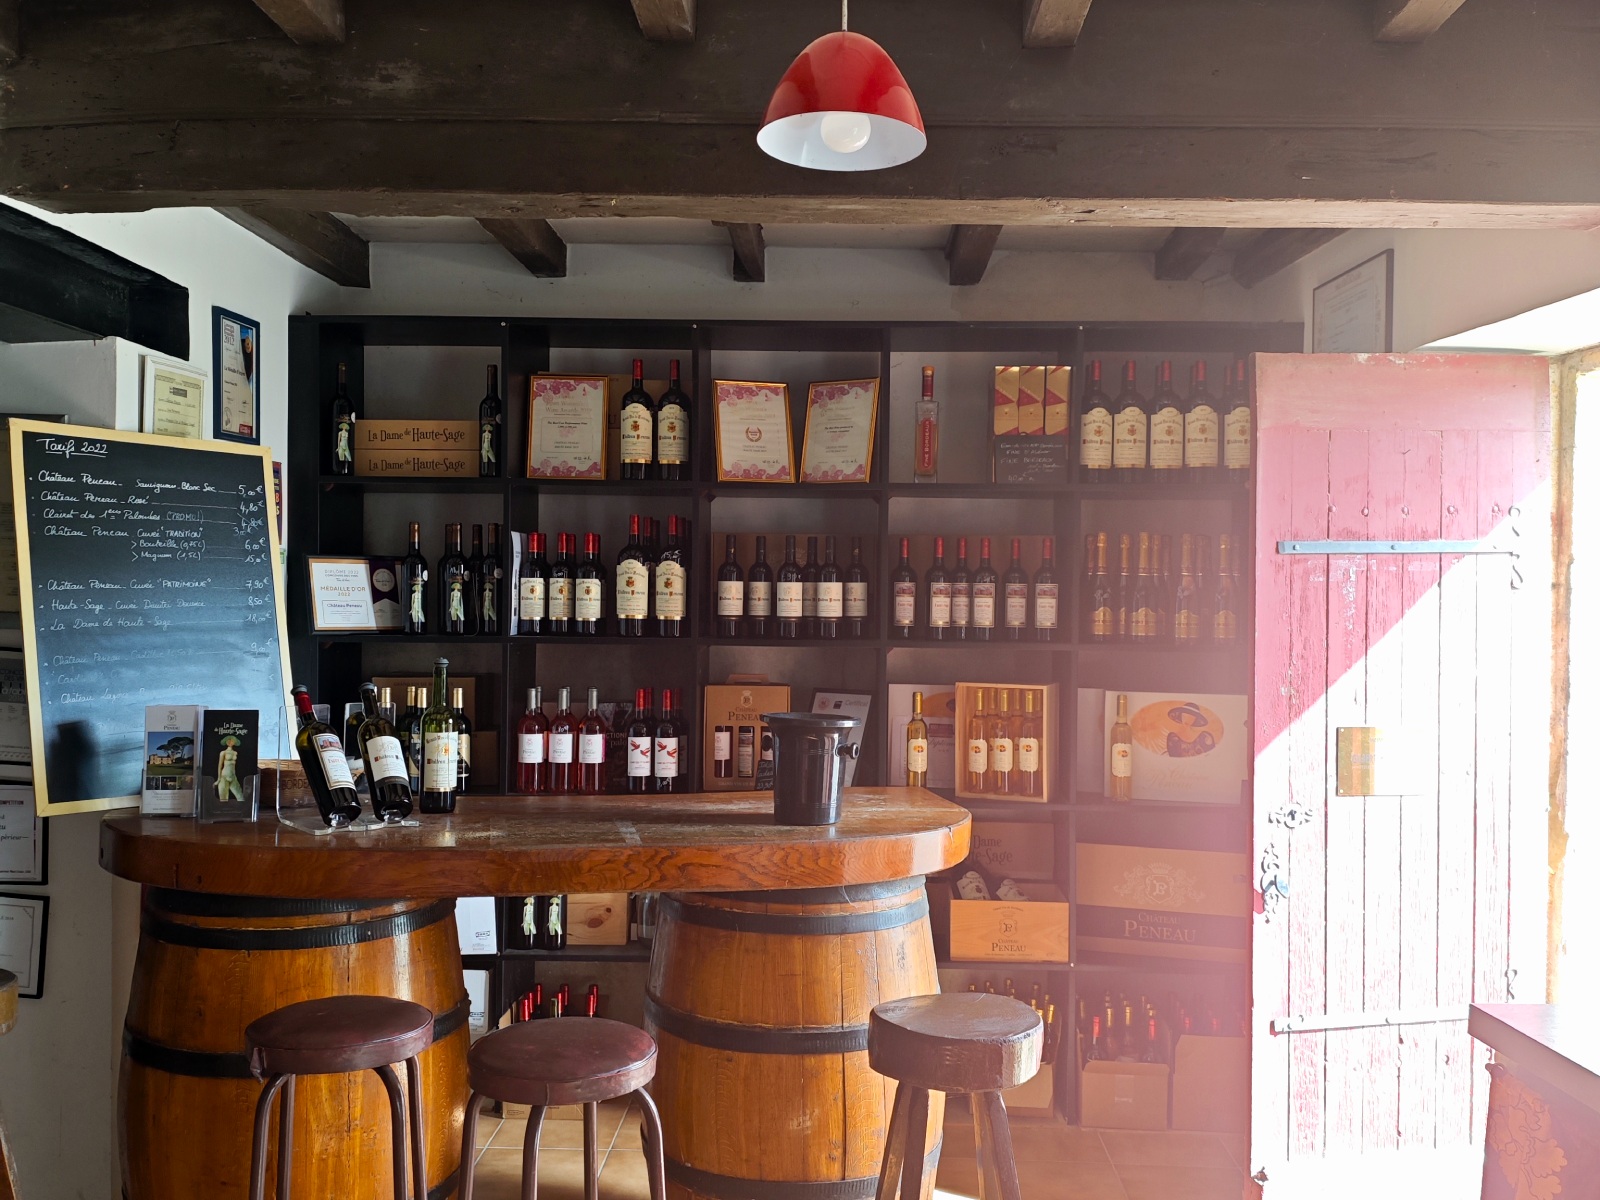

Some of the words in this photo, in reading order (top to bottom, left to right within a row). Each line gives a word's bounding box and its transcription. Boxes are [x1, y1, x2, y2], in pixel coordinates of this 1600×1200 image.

[368, 430, 378, 442] La
[380, 430, 403, 442] Dame
[404, 428, 411, 436] de
[412, 428, 465, 442] Haute-Sage
[80, 441, 108, 454] 2022
[368, 459, 378, 472] La
[381, 459, 404, 471] Dame
[404, 457, 412, 465] de
[412, 457, 466, 472] Haute-Sage
[38, 470, 76, 483] Château
[80, 473, 117, 486] Peneau
[181, 482, 200, 491] Blanc
[203, 483, 216, 492] Sec
[40, 491, 79, 502] Château
[44, 525, 87, 537] Château
[92, 526, 129, 537] Peneau
[141, 551, 172, 562] Magnum
[47, 579, 85, 591] Château
[73, 618, 99, 629] Dame
[53, 655, 87, 667] Château
[61, 691, 95, 704] Château
[973, 835, 1001, 849] Dame
[1138, 912, 1180, 924] CHÂTEAU
[1123, 919, 1197, 942] PENEAU
[991, 942, 1026, 952] PENEAU
